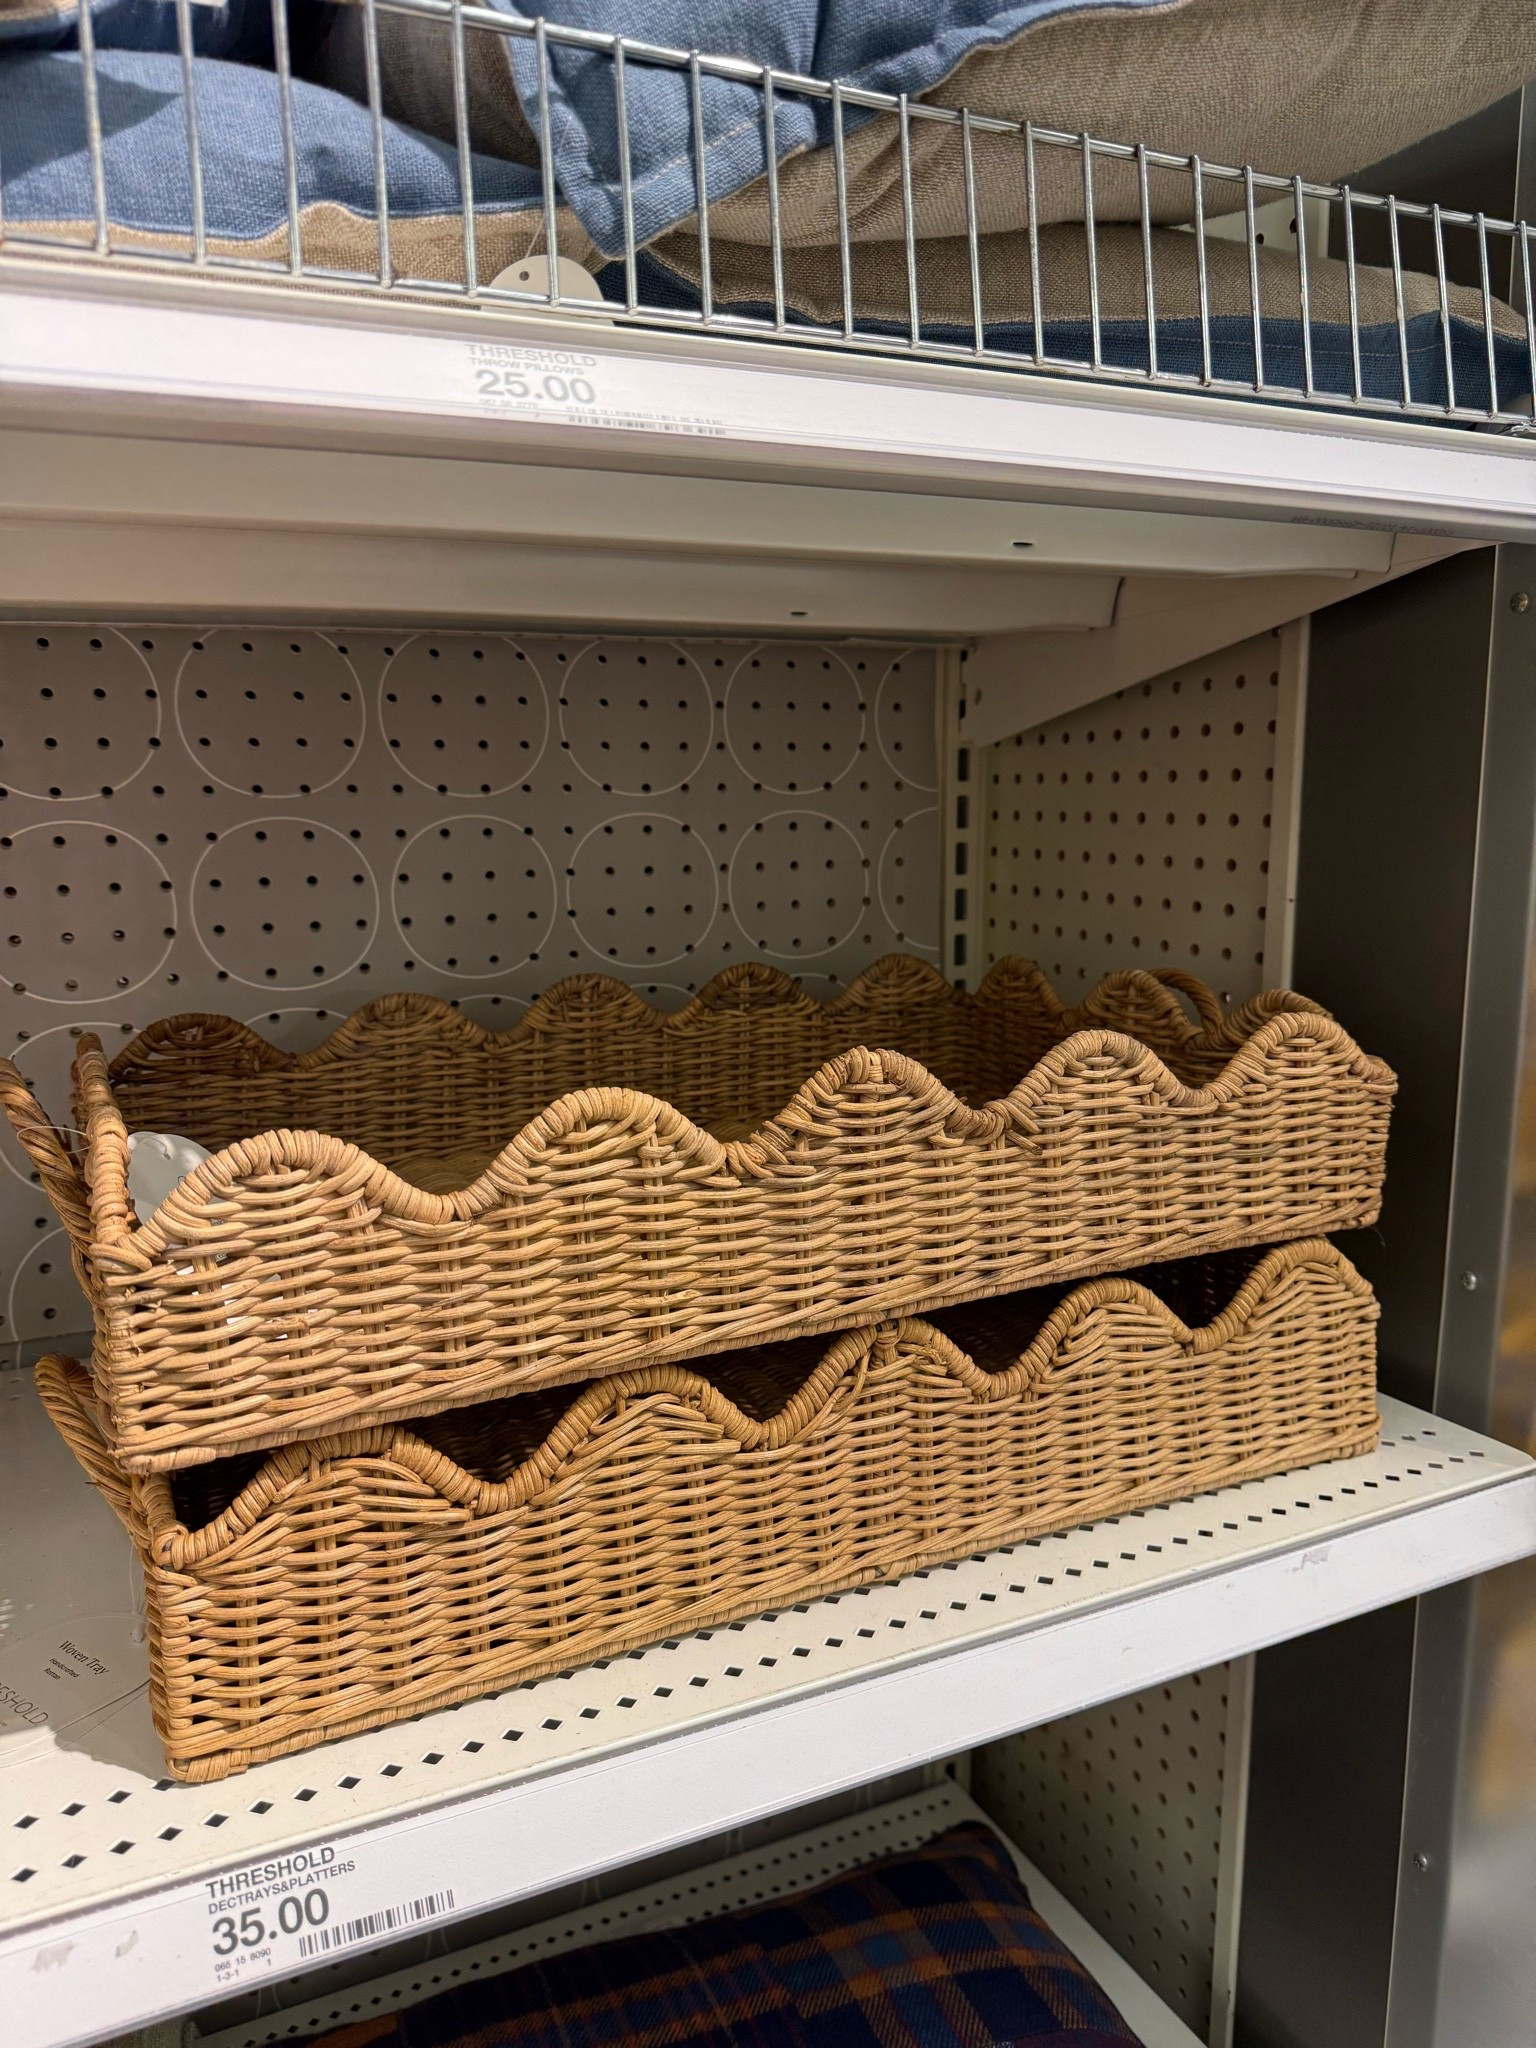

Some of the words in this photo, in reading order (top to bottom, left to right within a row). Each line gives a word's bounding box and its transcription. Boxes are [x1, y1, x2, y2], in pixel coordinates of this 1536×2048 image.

[465, 344, 597, 367] THRESHOLD
[468, 356, 520, 369] THROW
[523, 362, 585, 376] PILLOWS
[475, 369, 596, 404] 25.00
[49, 1657, 80, 1678] Handcrafted
[59, 1640, 89, 1663] Woven
[85, 1657, 110, 1675] Tray
[205, 1847, 335, 1899] THRESHOLD
[208, 1860, 355, 1915] DECTRAYS&PLATTERS
[212, 1888, 330, 1955] 35.00
[235, 1955, 246, 1965] 15
[250, 1947, 272, 1960] 8090
